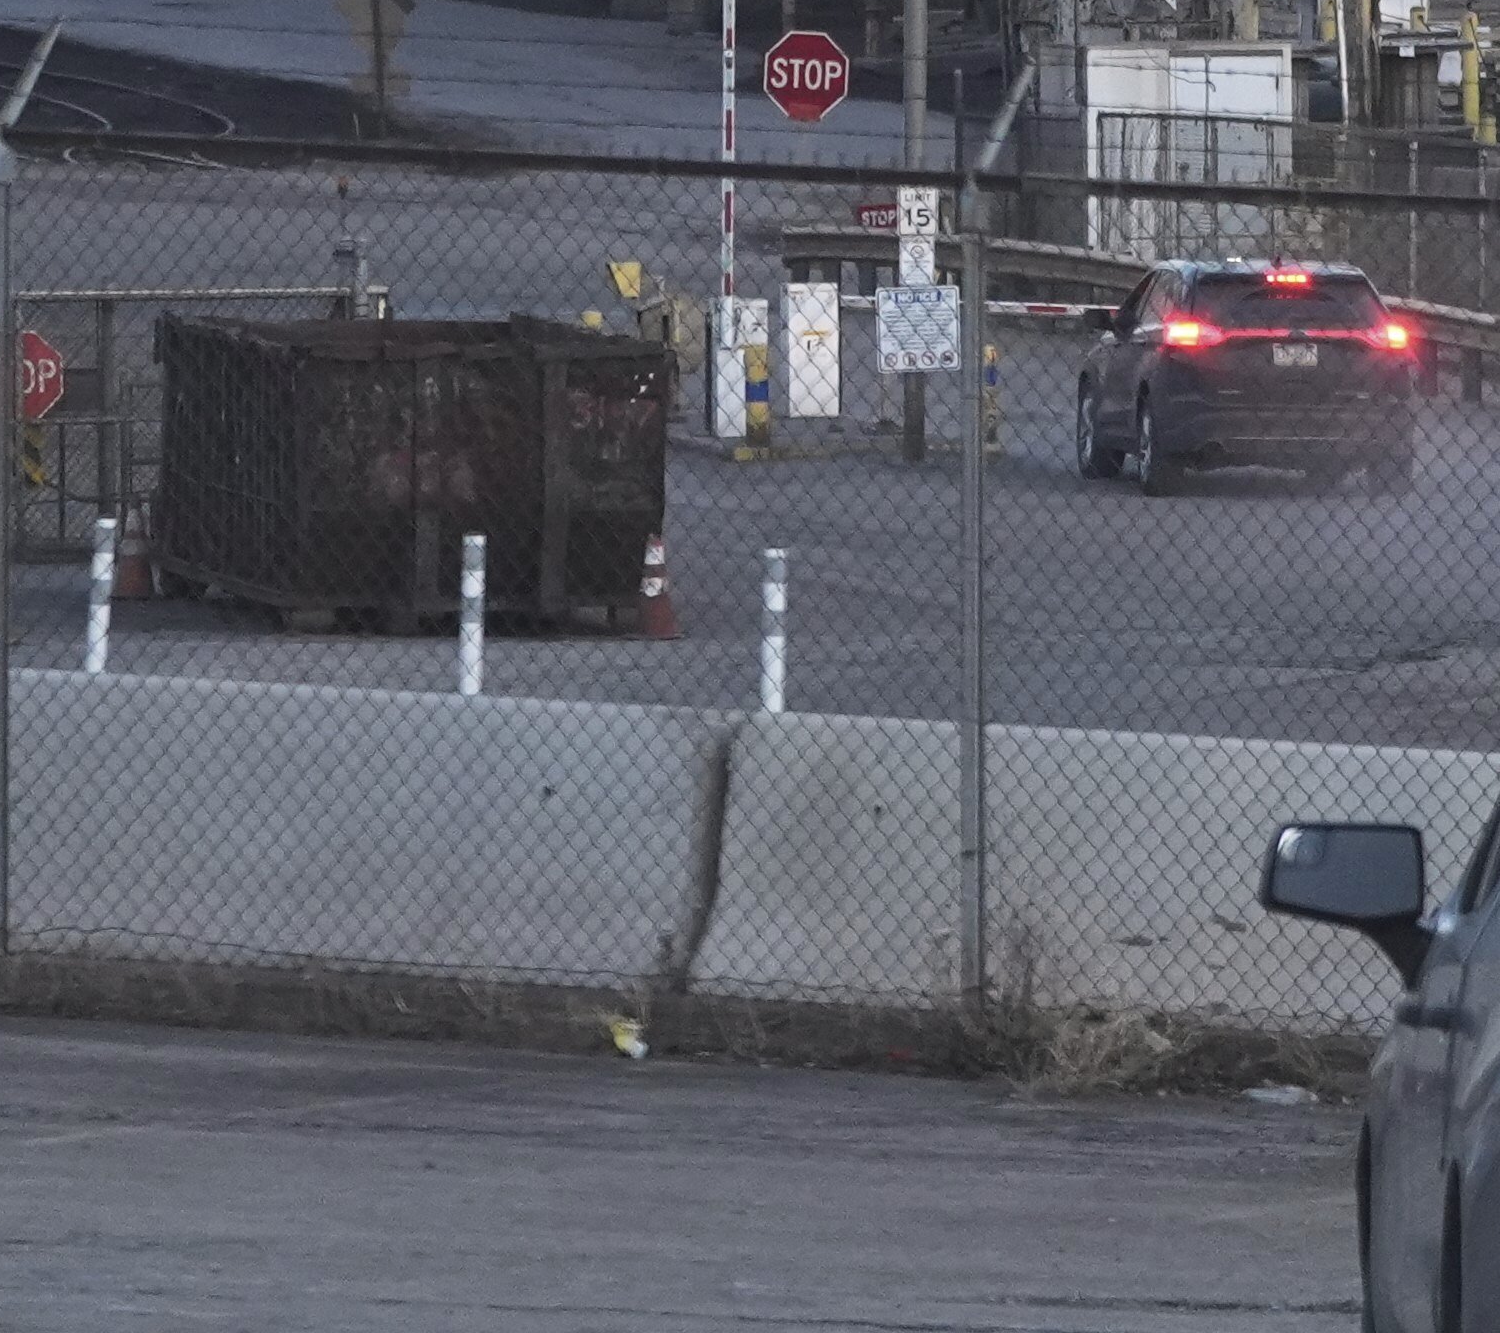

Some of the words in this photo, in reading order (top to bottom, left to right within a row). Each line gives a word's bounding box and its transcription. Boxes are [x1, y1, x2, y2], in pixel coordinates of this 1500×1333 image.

[770, 57, 843, 91] STOP
[904, 192, 931, 202] LIMIT
[861, 208, 896, 227] STOP
[906, 208, 930, 227] 15
[898, 290, 939, 303] NOTICE
